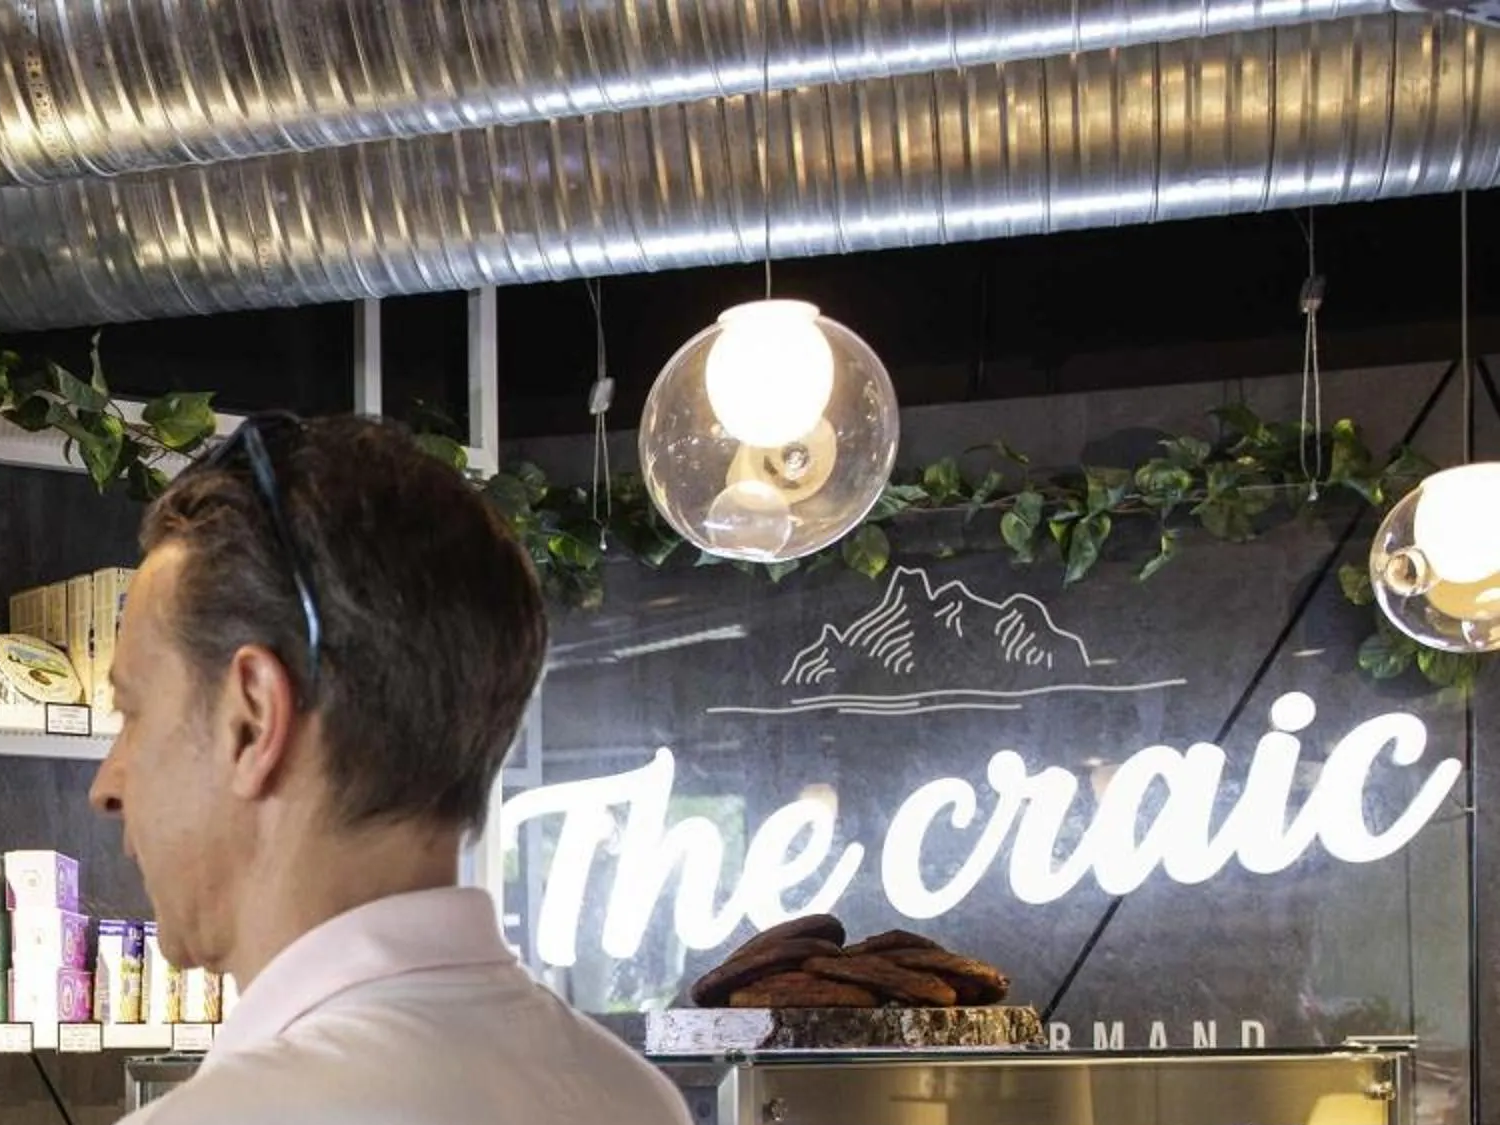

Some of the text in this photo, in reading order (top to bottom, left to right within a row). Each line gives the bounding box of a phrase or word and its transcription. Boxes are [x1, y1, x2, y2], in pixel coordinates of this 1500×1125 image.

[500, 691, 1462, 967] The craic
[1048, 1020, 1266, 1051] RMAND
